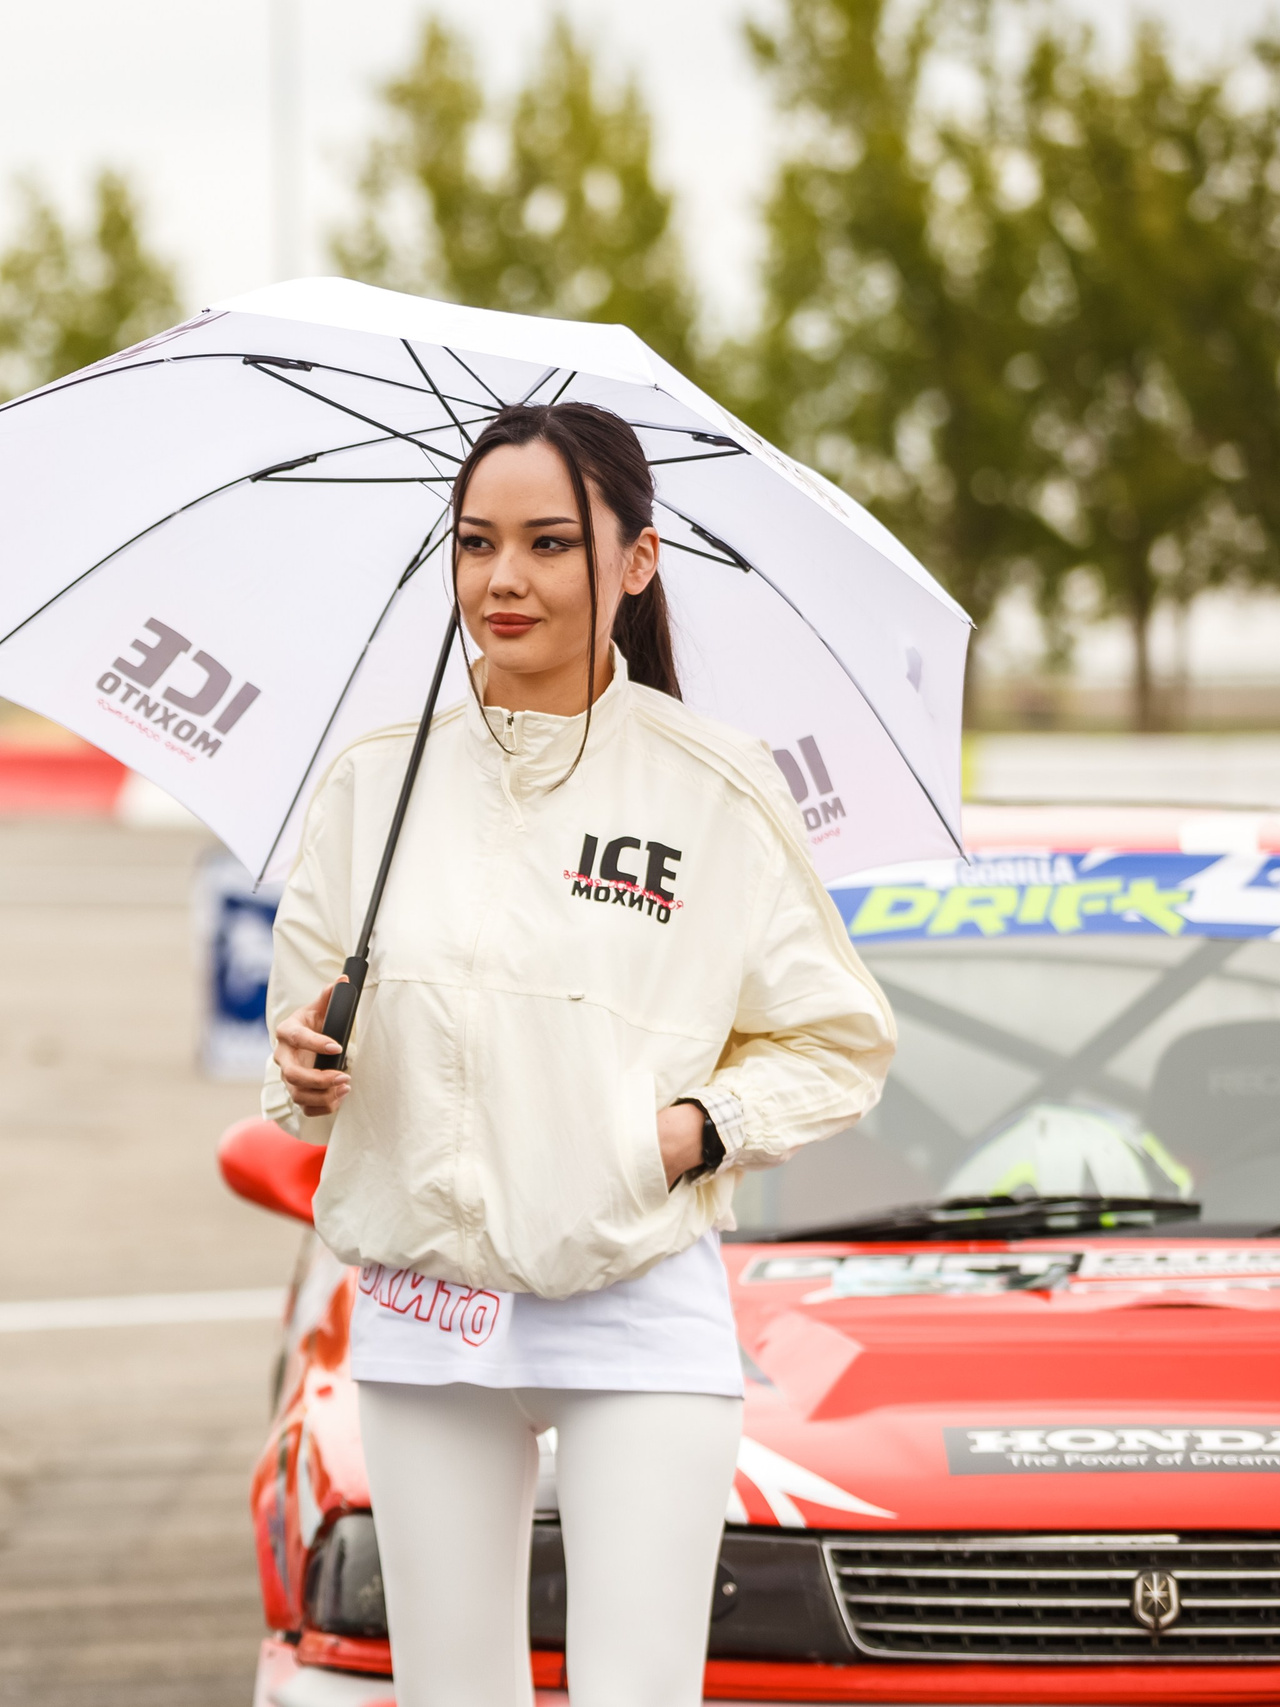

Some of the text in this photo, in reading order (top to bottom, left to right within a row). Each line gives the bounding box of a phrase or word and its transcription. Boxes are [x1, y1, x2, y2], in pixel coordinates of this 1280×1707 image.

[578, 833, 683, 902] ICE
[571, 880, 672, 924] МОХИТО
[1006, 1452, 1059, 1467] The
[1064, 1452, 1149, 1467] Power
[1155, 1451, 1184, 1466] of
